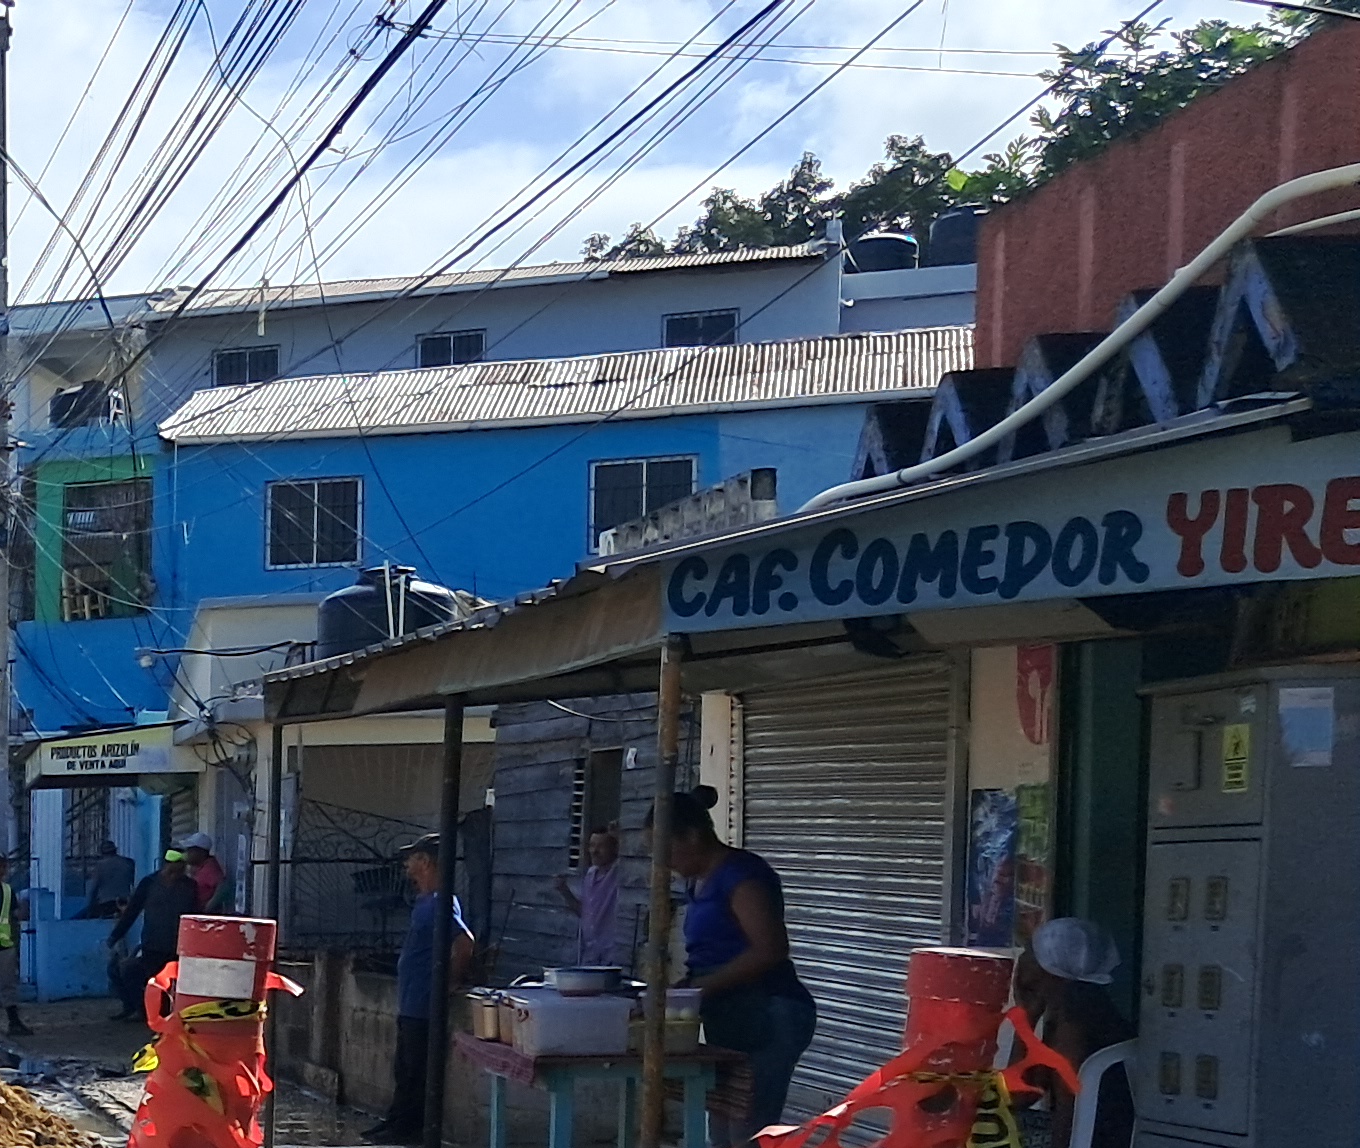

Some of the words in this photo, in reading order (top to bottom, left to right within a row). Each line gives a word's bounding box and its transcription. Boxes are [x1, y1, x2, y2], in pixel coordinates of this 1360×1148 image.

[667, 548, 799, 618] CAF.
[809, 510, 1150, 608] COMEDOR
[51, 746, 98, 760] PRODUCTOS
[67, 761, 76, 770] DE
[79, 759, 106, 770] VENTA
